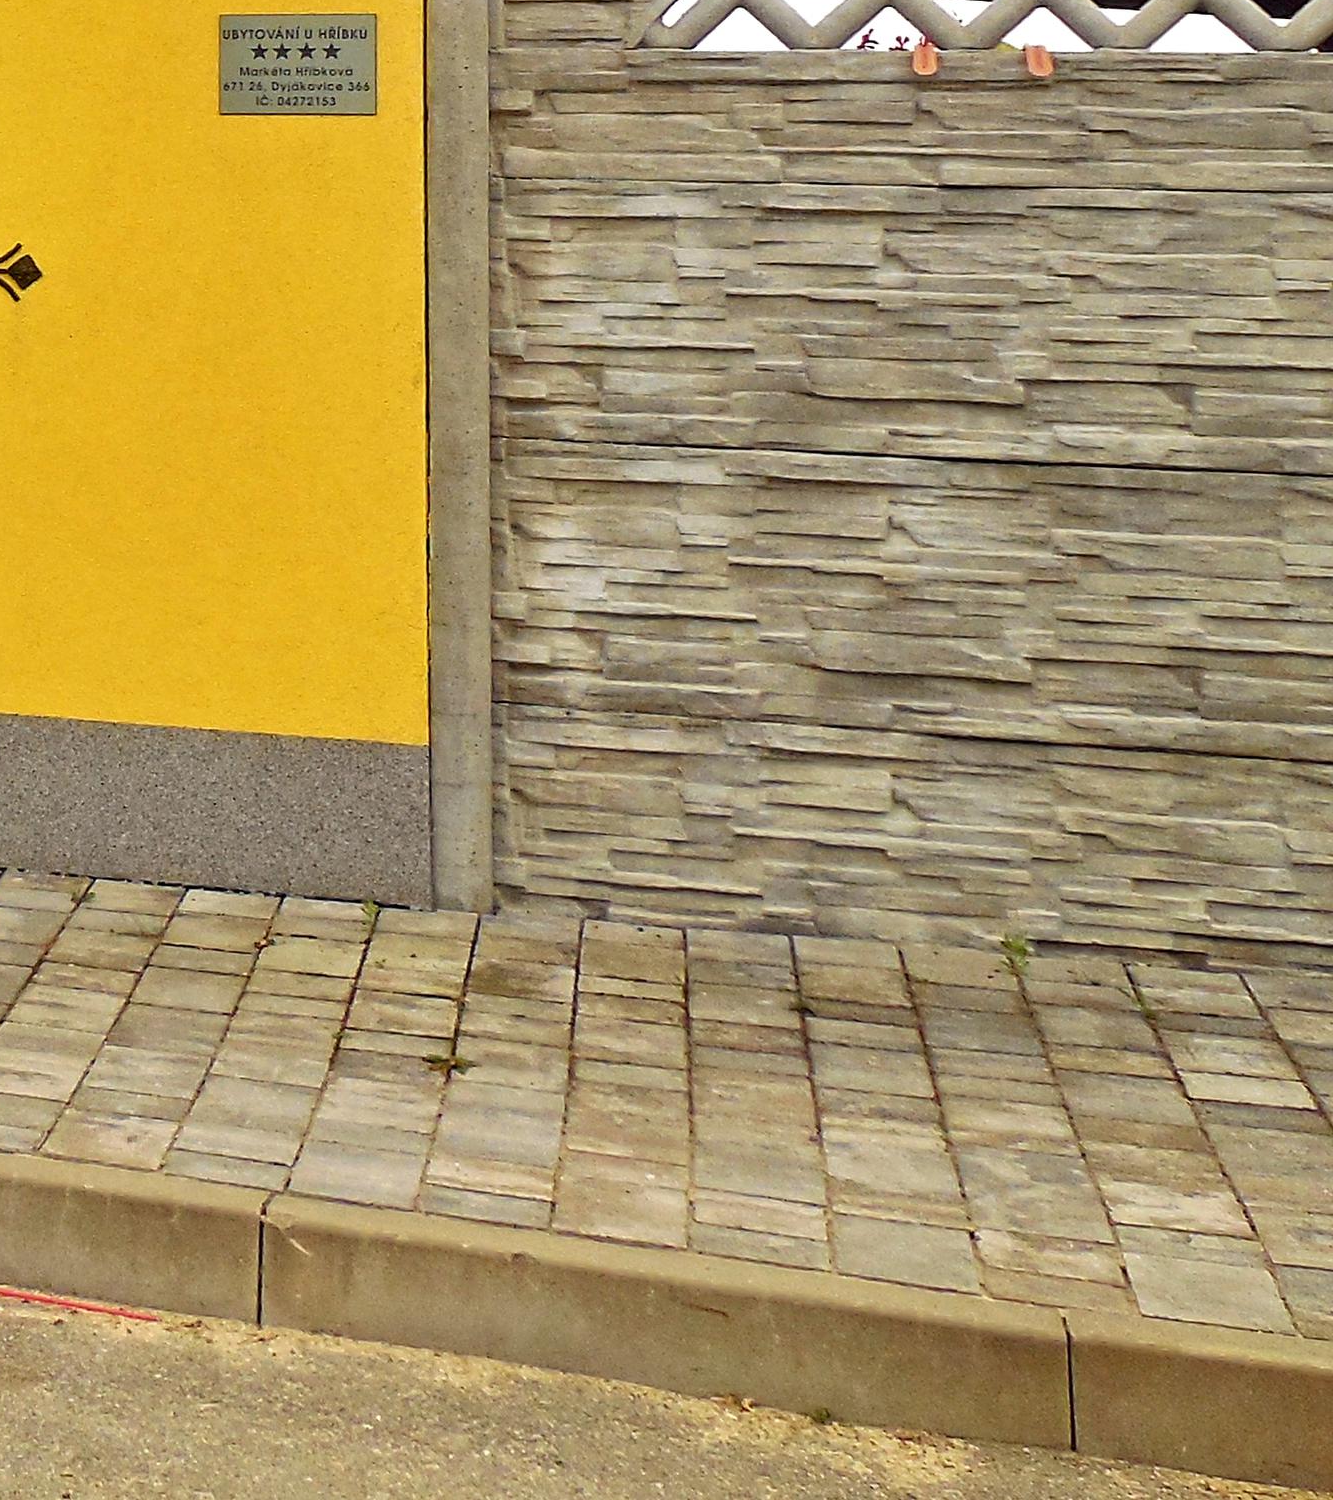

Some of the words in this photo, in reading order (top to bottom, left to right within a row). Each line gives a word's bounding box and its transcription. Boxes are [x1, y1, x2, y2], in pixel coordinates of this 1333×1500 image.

[222, 26, 300, 40] UBYTOVÁNÍ
[304, 29, 313, 39] U
[223, 81, 244, 92] 671
[348, 81, 371, 92] 366
